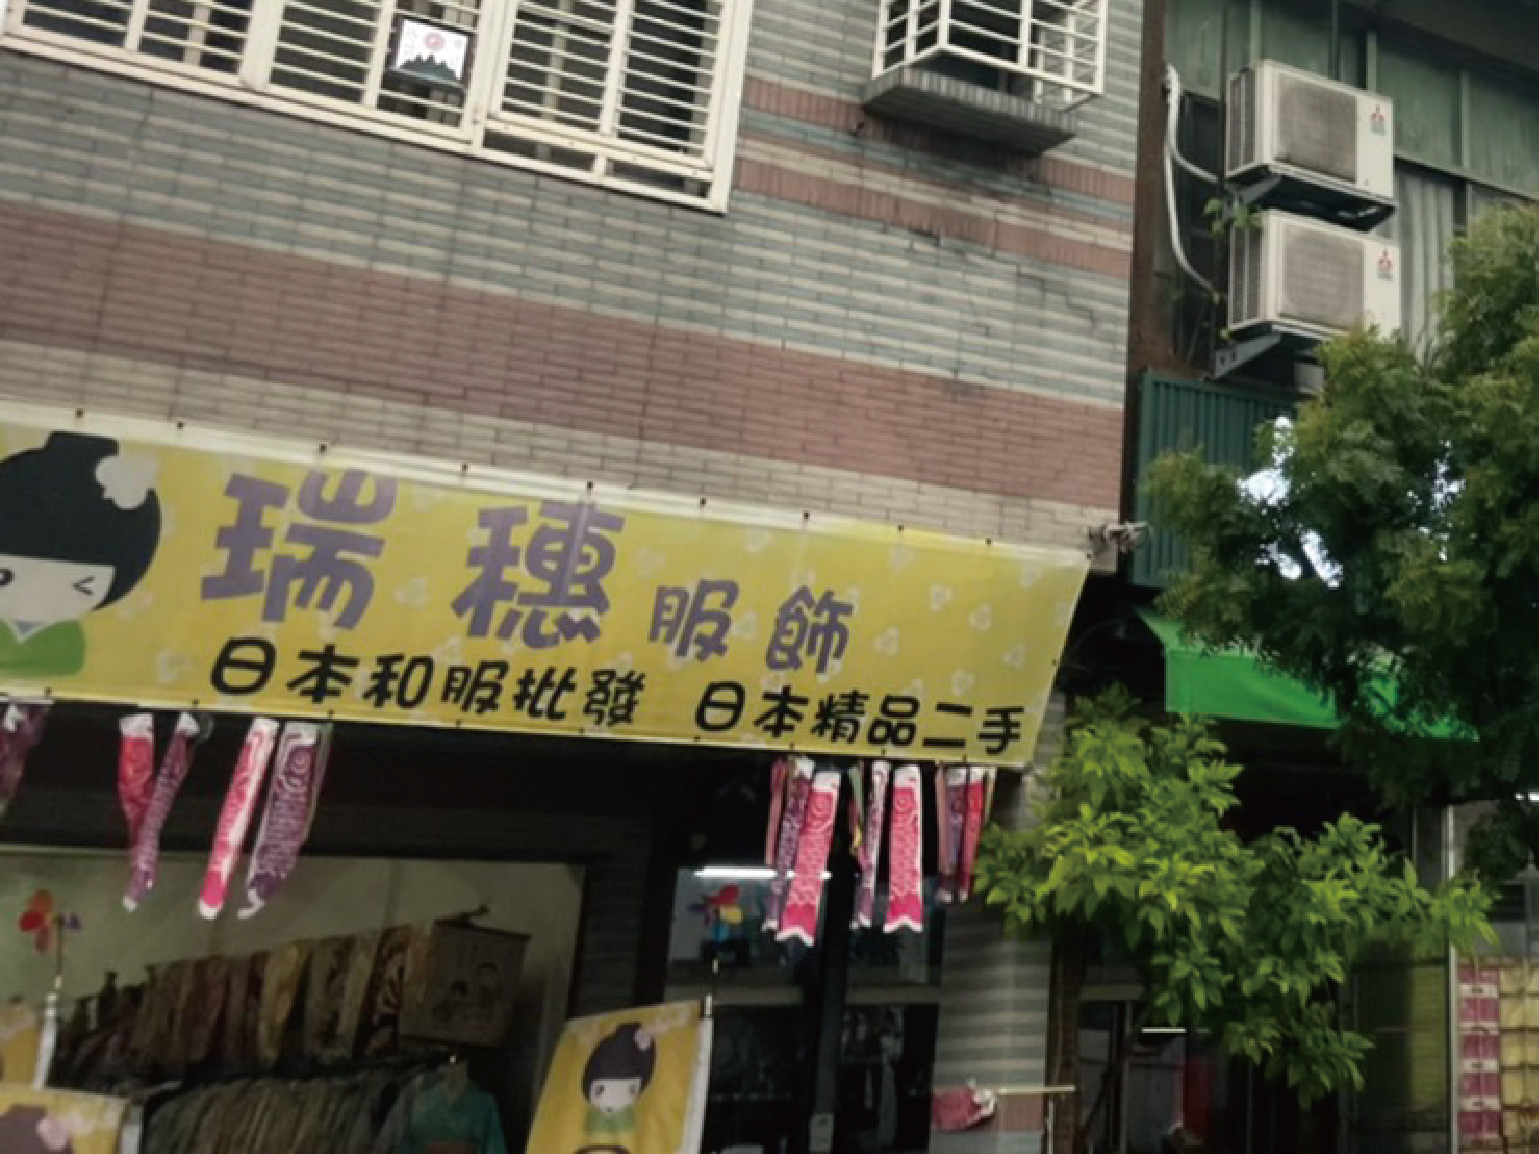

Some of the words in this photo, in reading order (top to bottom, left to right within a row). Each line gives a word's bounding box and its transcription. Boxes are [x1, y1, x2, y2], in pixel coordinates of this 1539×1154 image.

[209, 636, 645, 728] 日本和服批發
[695, 680, 1025, 755] 日本精品二手
